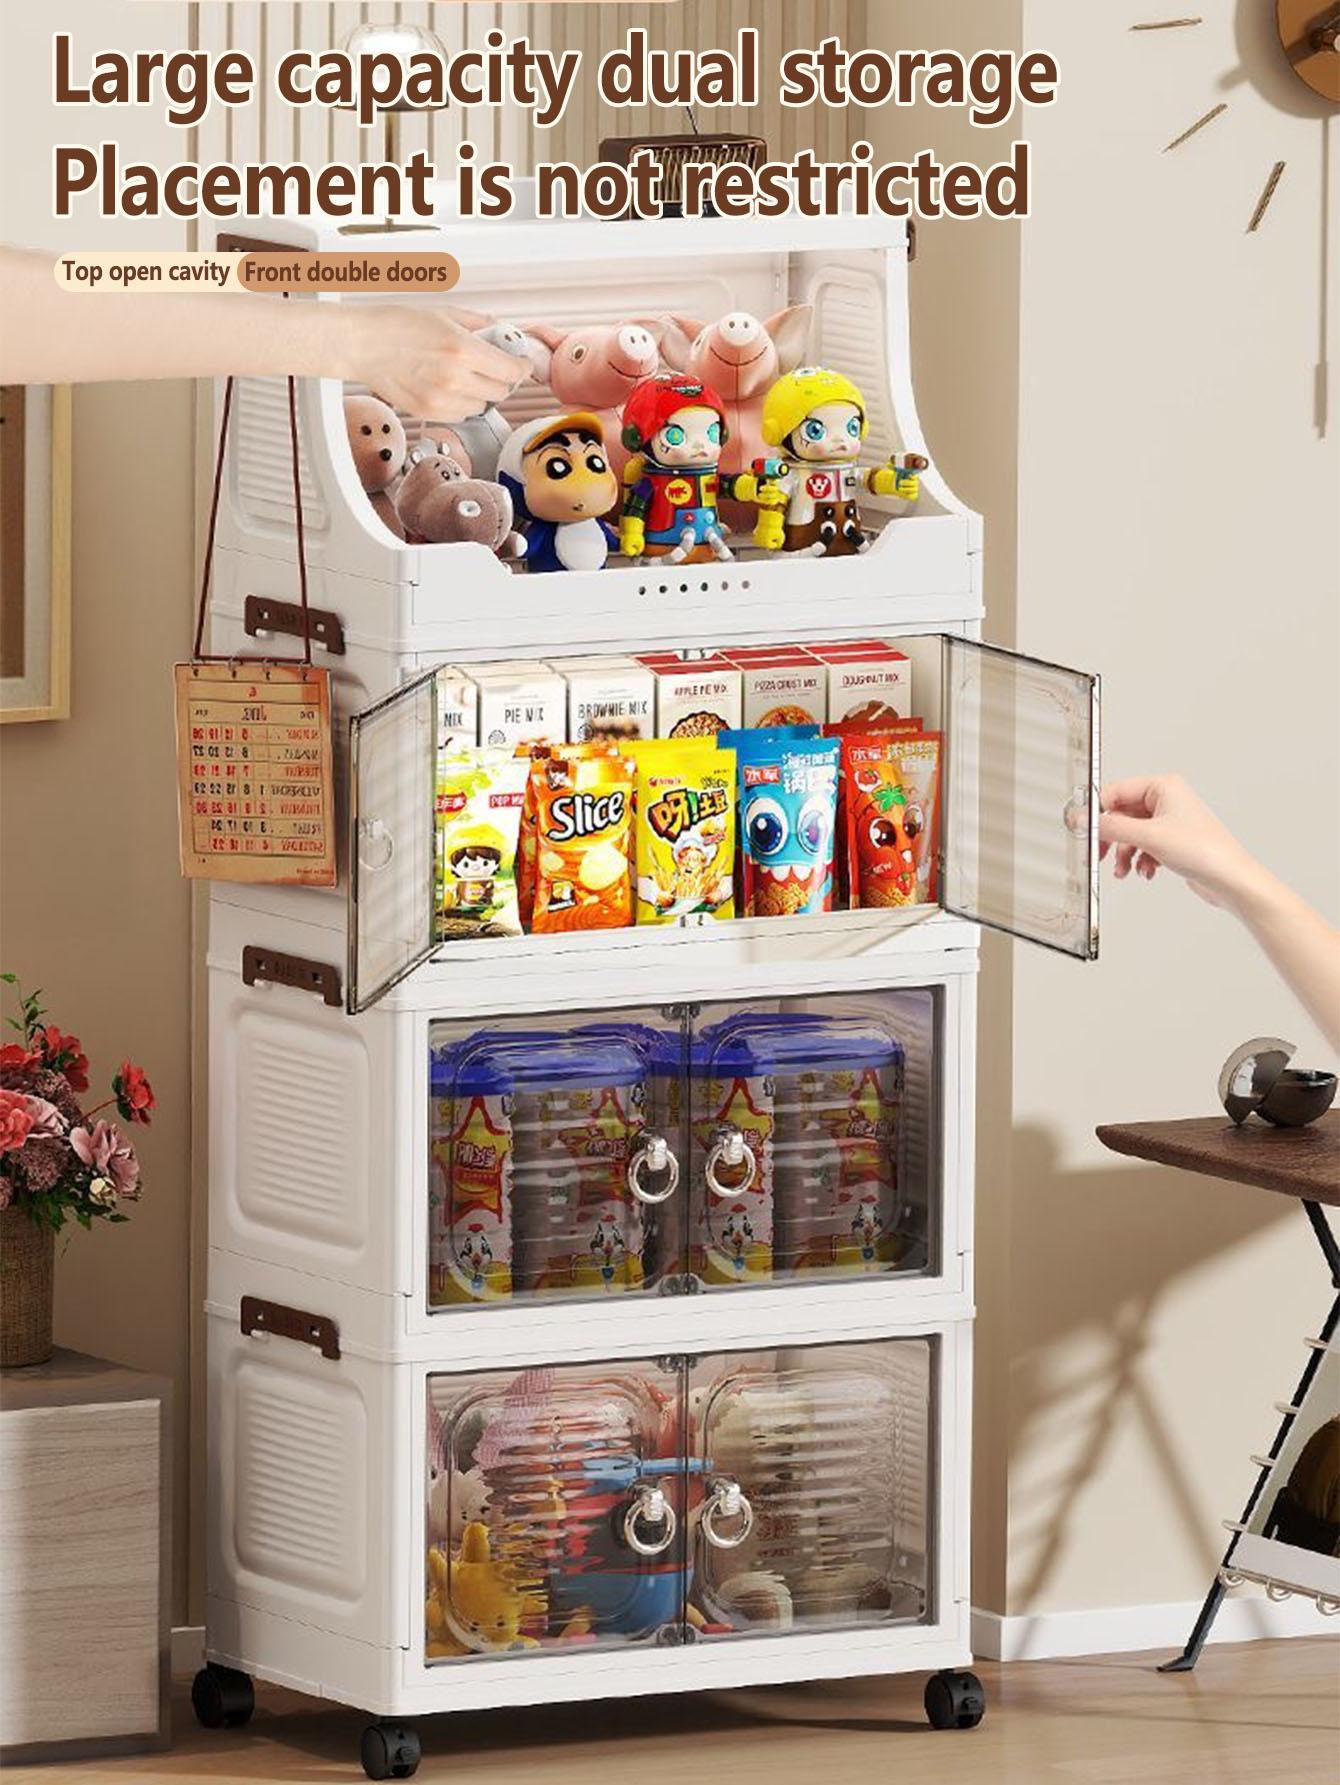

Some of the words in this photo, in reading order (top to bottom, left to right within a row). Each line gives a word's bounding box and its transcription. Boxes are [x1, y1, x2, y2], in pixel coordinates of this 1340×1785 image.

[754, 680, 774, 691] PIZZA
[803, 679, 818, 689] MIX
[843, 674, 884, 687] DOUGHNUT
[885, 673, 899, 683] MIX
[674, 685, 698, 697] APPLE
[504, 708, 521, 723] PIE
[525, 707, 545, 722] MIX
[578, 702, 625, 719] BROWNIE
[629, 700, 648, 716] MIX
[444, 712, 462, 728] MIX
[548, 791, 625, 842] Slice
[648, 788, 729, 843] 呀!土豆
